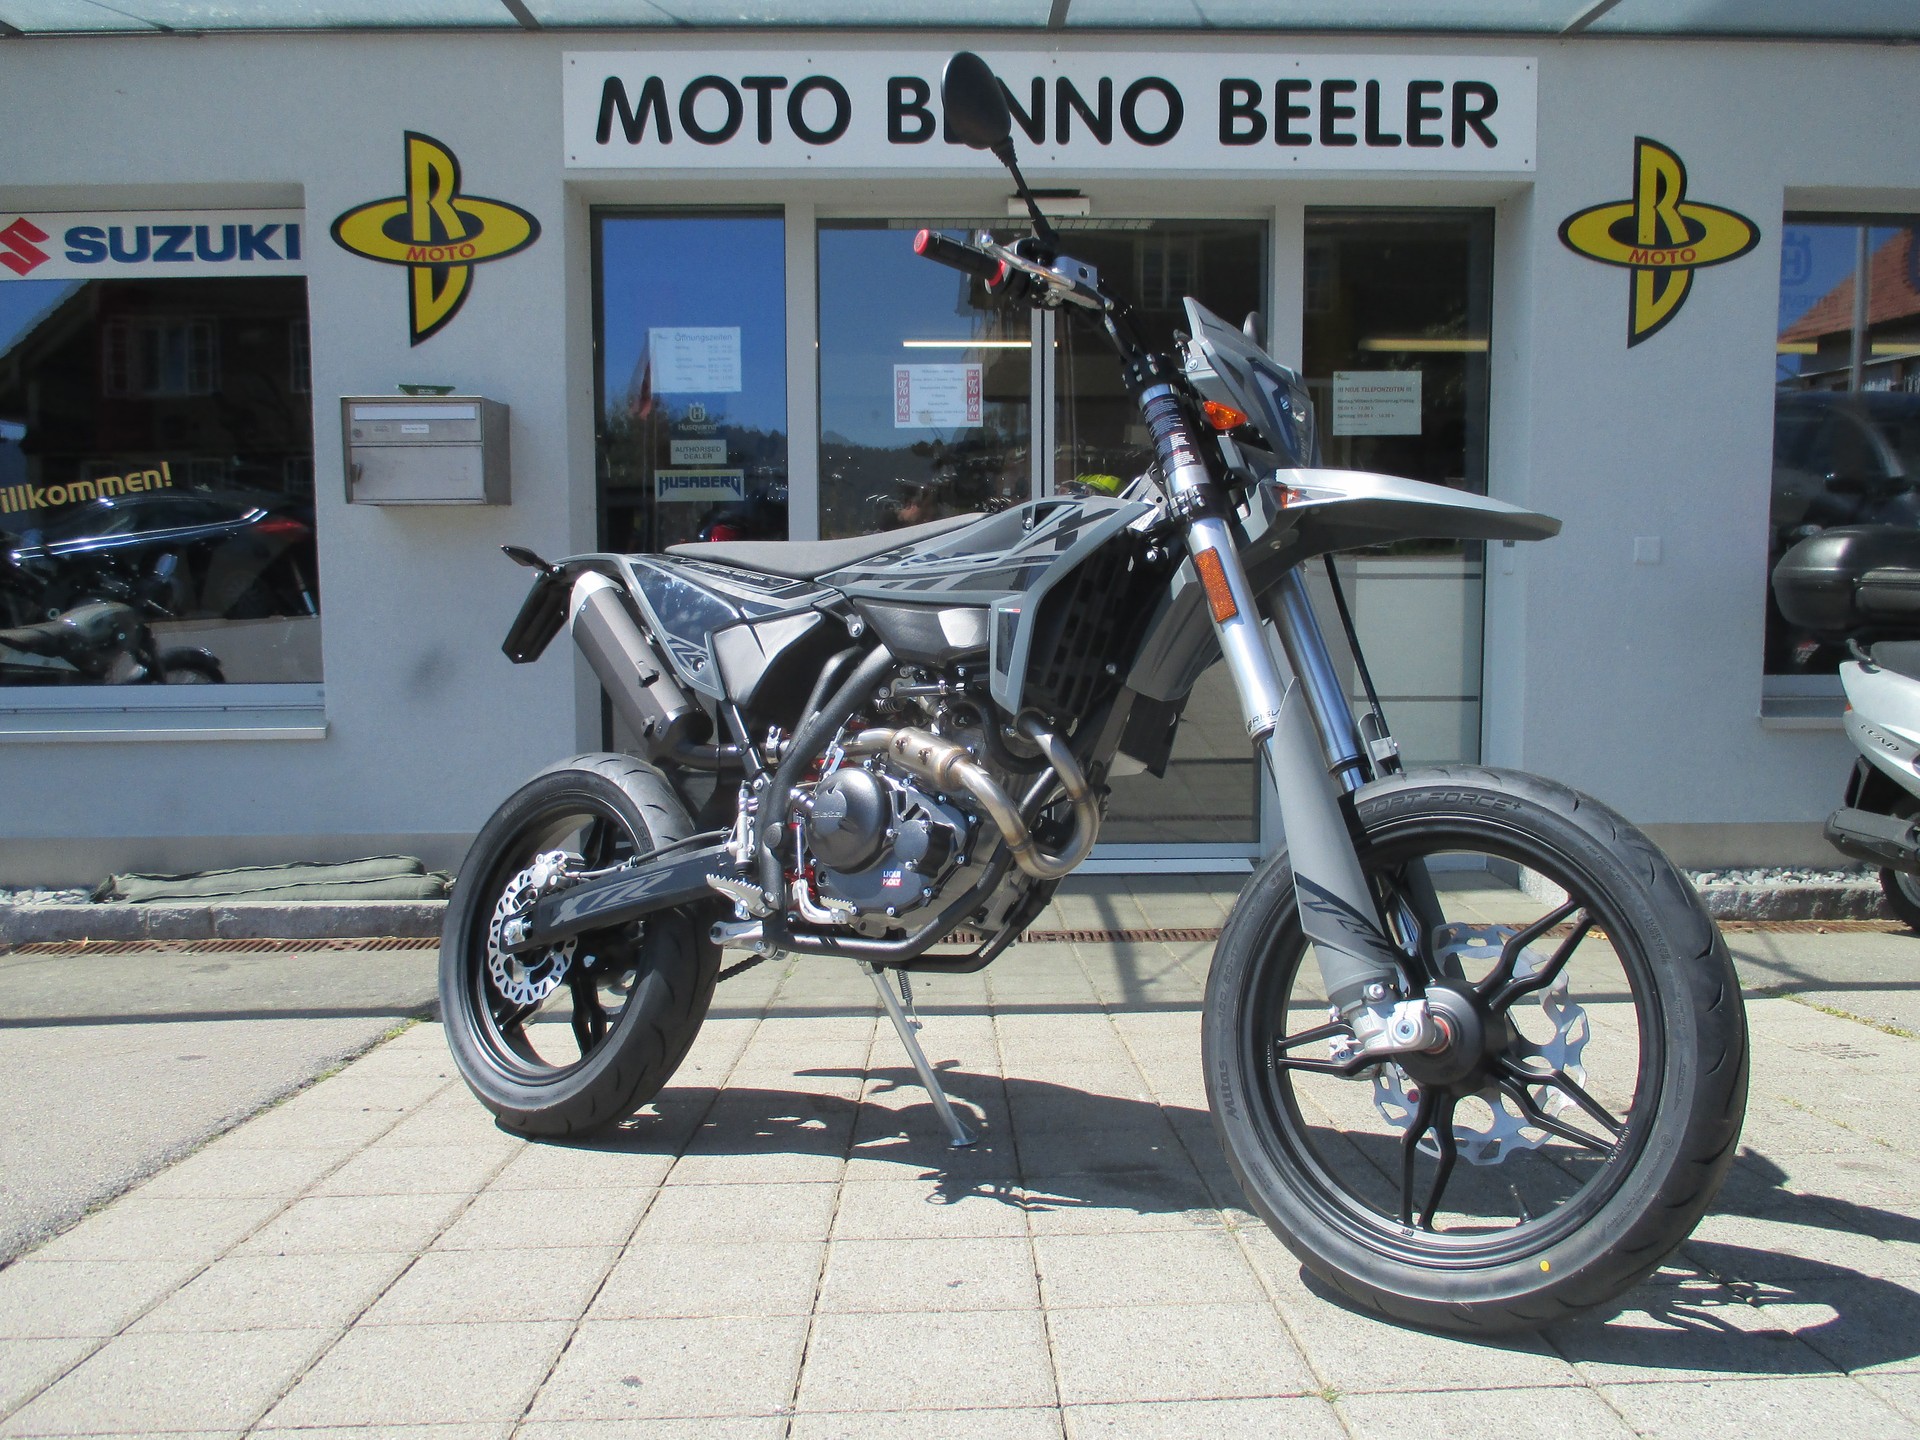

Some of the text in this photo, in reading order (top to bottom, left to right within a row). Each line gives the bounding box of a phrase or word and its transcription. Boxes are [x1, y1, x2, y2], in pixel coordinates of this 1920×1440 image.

[595, 74, 1499, 149] MOTO BNNO BEELER
[64, 224, 300, 263] SUZUKI
[406, 243, 476, 262] MOTO
[1628, 248, 1697, 265] MOTO
[674, 331, 733, 343] Öffnungszeiten
[678, 423, 717, 432] Husqvarna
[0, 461, 173, 513] illkommen!
[659, 475, 741, 497] HUSABERG
[698, 564, 766, 581] SPECIAL EDITION
[1359, 792, 1422, 819] PORT
[882, 878, 902, 886] MOLY
[883, 870, 902, 878] LIQUI
[1217, 1059, 1239, 1123] Mitas
